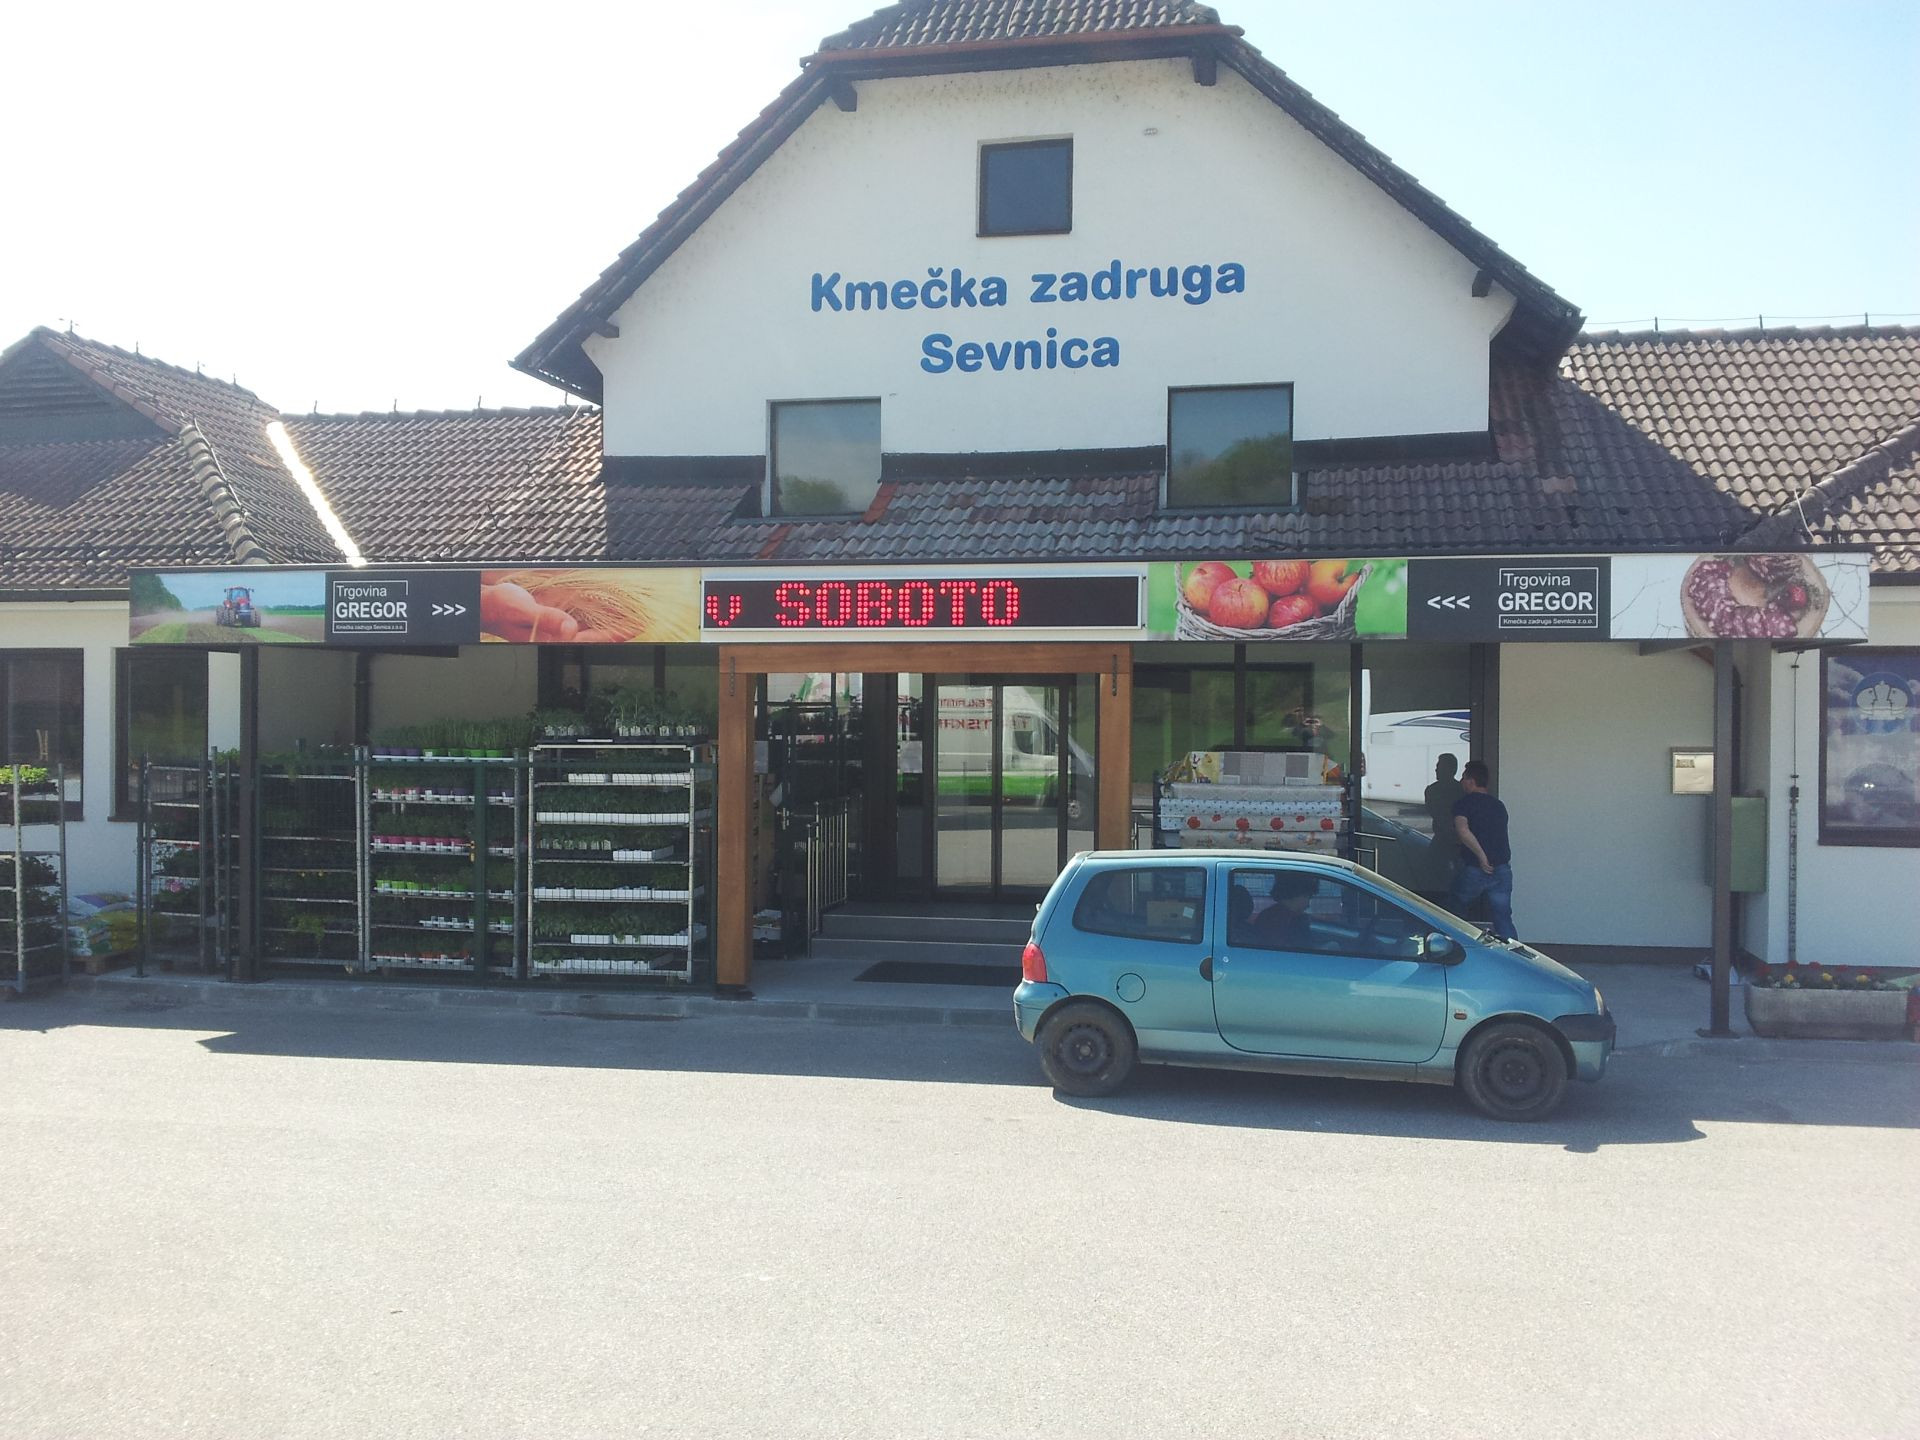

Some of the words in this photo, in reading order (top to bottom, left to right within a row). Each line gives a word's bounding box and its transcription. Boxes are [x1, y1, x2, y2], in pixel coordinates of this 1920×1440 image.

[810, 266, 1007, 313] Kmečka
[1029, 258, 1246, 306] zadruga
[920, 327, 1120, 374] Sevnica
[1502, 572, 1572, 590] Trgovina
[335, 585, 388, 600] Trgovina
[1498, 592, 1594, 612] GREGOR
[335, 601, 408, 619] GREGOR
[775, 580, 1020, 626] SOBOTO
[1503, 617, 1528, 625] Kmečka
[1528, 618, 1552, 626] zadruga
[1552, 617, 1577, 625] Sevnica
